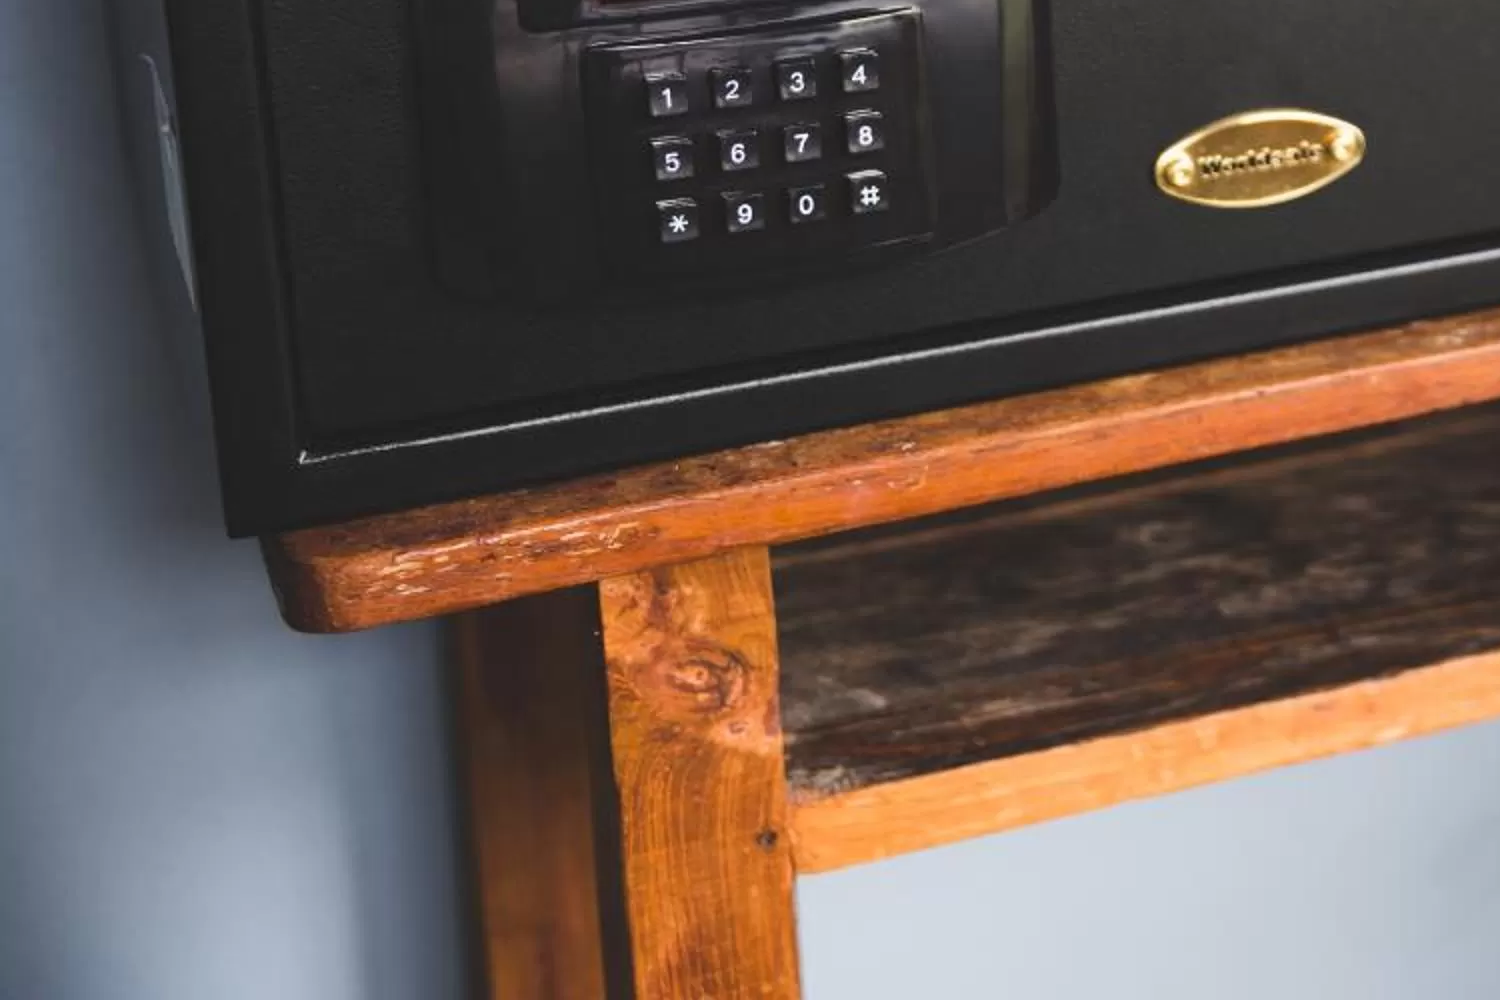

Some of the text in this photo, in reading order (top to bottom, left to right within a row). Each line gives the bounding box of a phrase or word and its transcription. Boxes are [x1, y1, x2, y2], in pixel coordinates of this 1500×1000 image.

[661, 64, 867, 110] 1 2 3 4
[665, 125, 874, 173] 5 6 7 8
[737, 203, 753, 225] 9
[799, 194, 815, 215] 0
[860, 185, 881, 206] #
